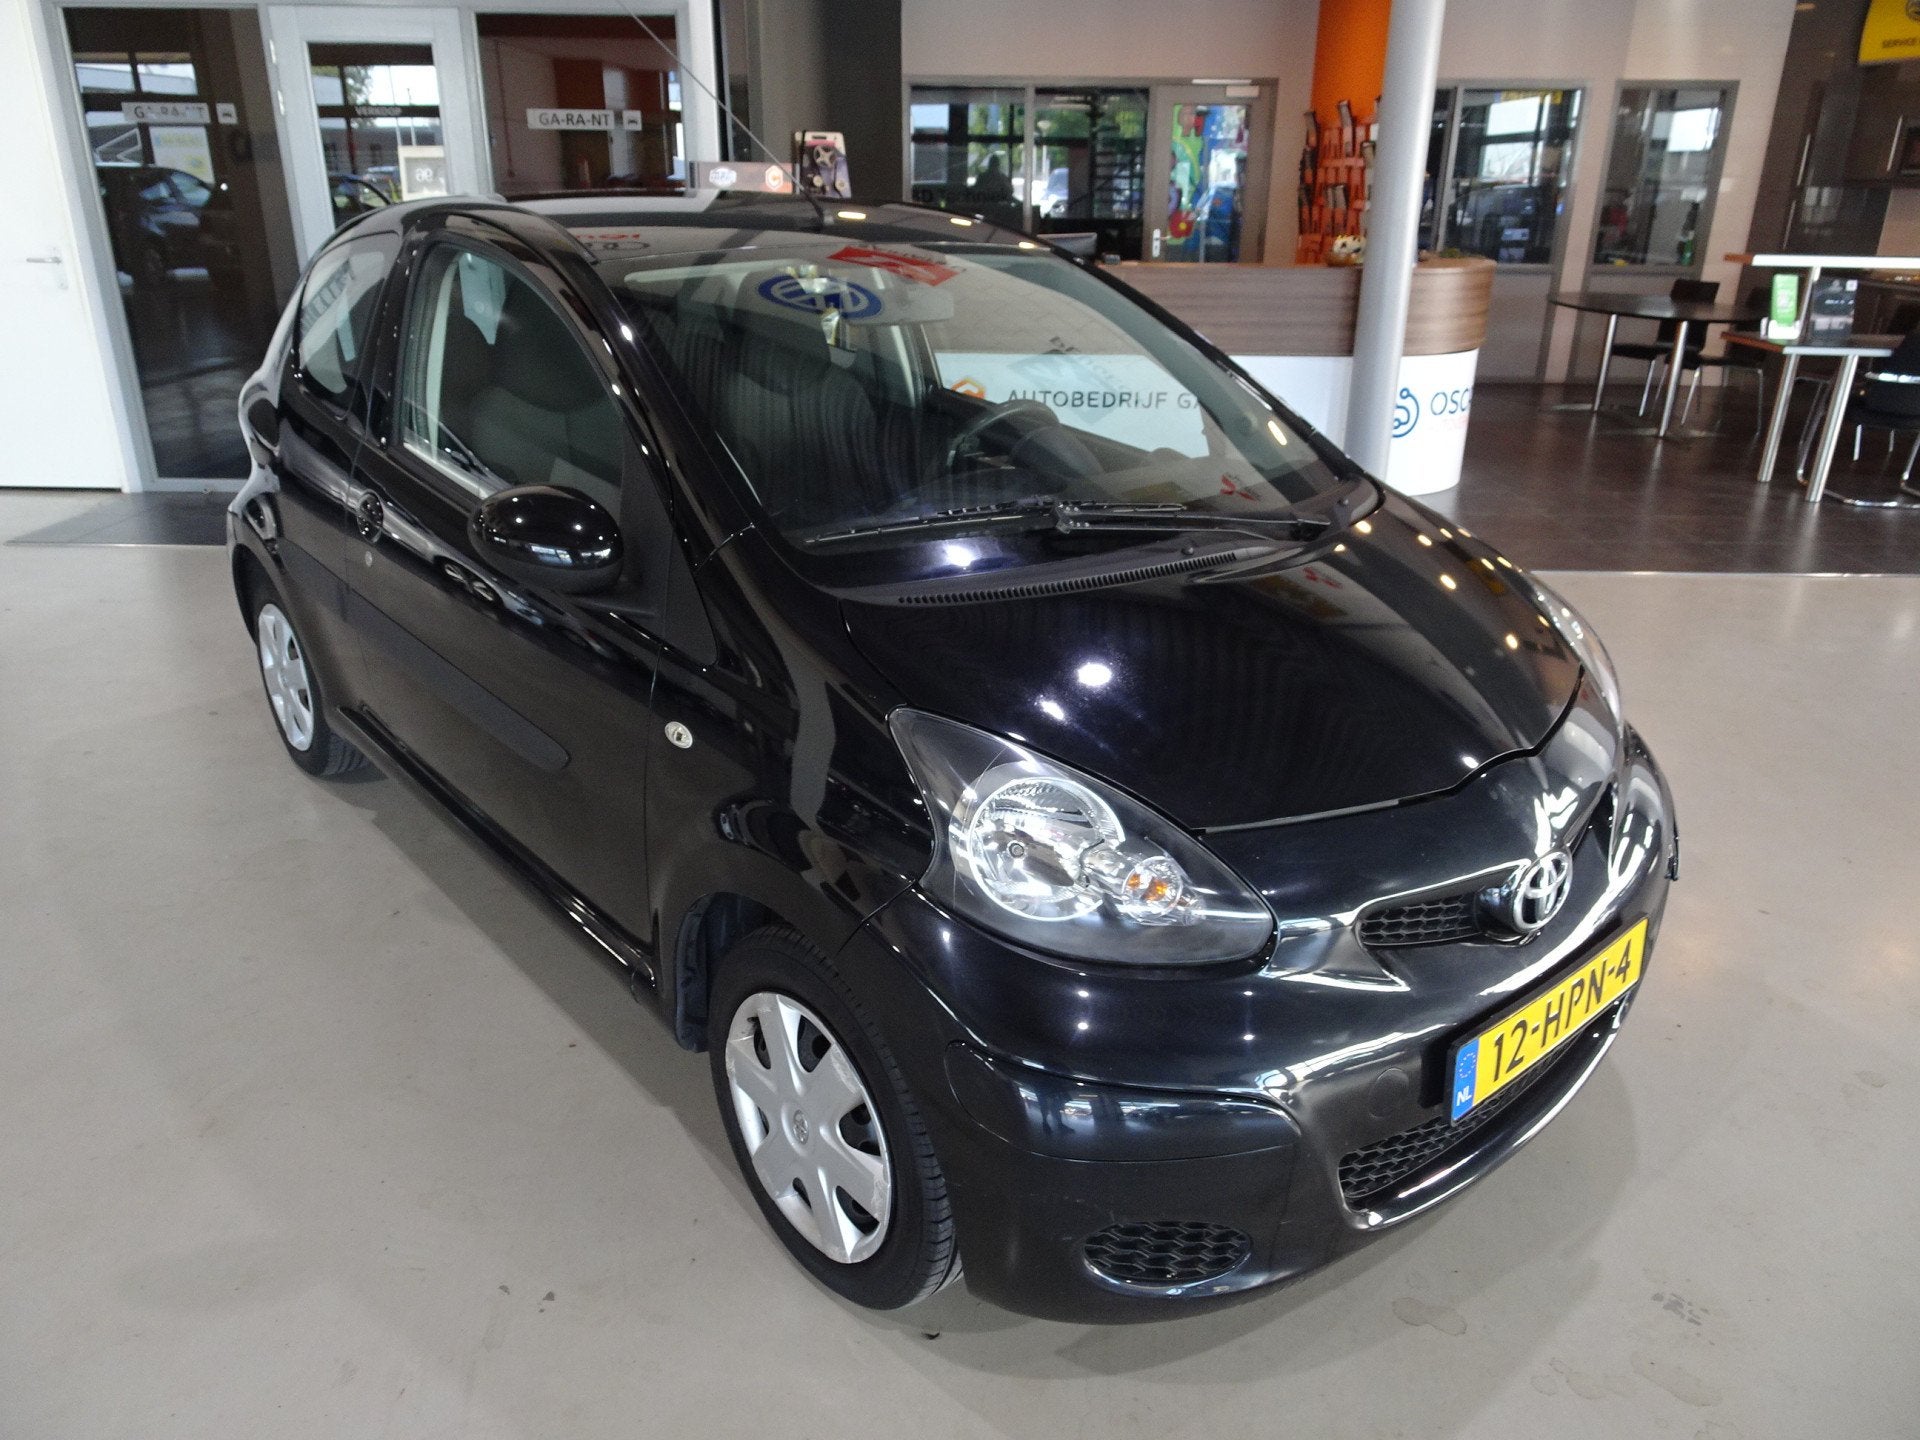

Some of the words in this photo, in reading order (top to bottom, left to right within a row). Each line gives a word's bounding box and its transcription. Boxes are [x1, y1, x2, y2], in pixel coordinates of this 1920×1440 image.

[538, 112, 610, 126] GA-RA-NT
[1008, 389, 1168, 409] AUTOBEDRIJF
[1429, 387, 1472, 416] OSC
[1493, 938, 1632, 1083] 12-HPN-4
[1456, 1085, 1473, 1107] NL
